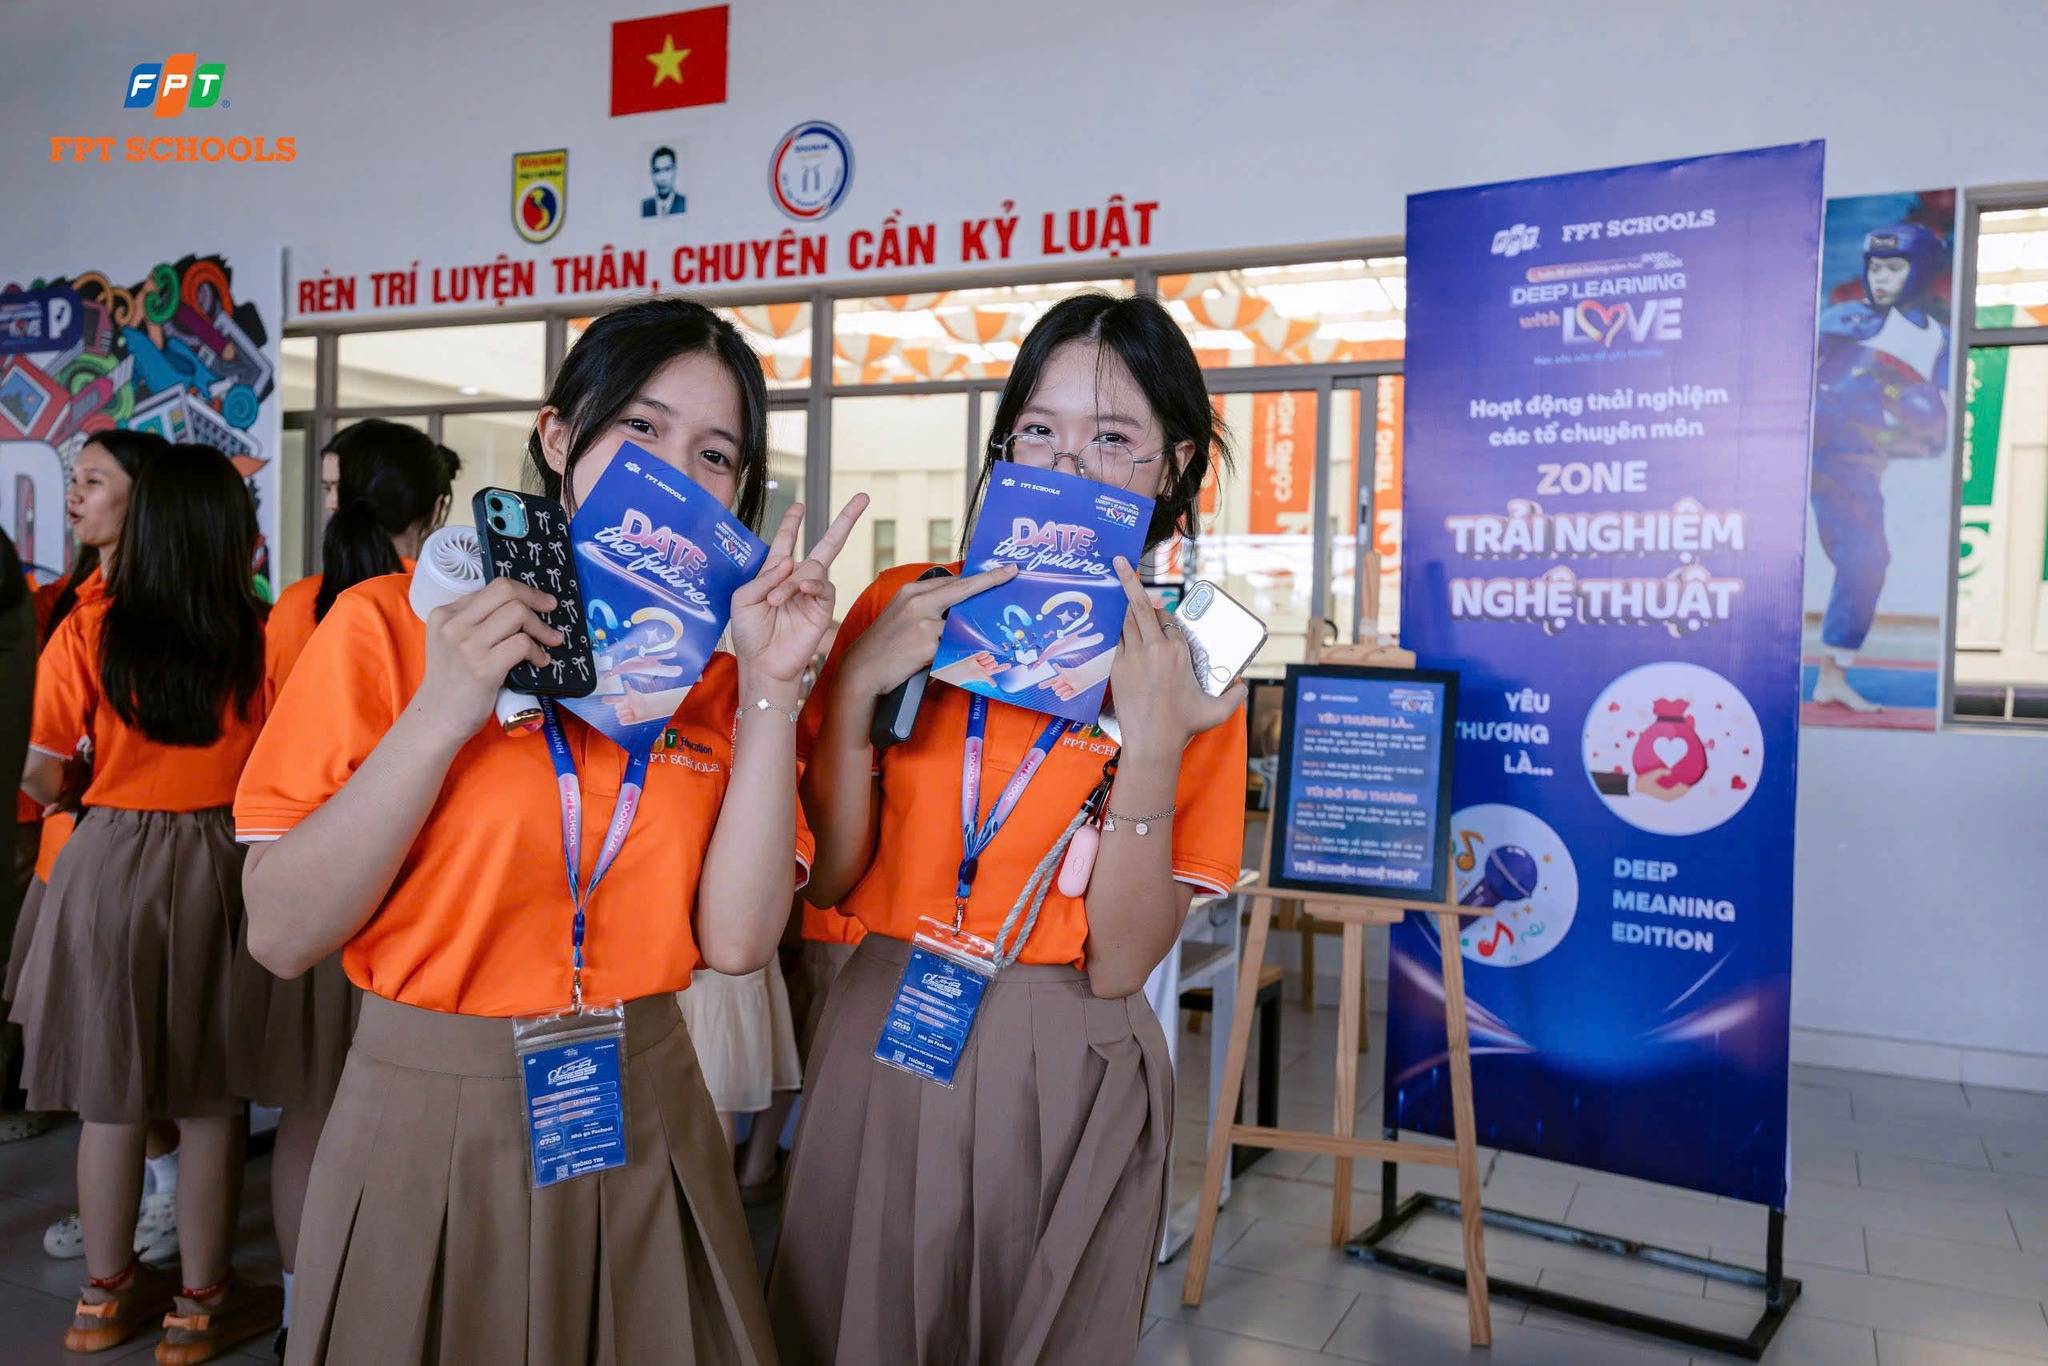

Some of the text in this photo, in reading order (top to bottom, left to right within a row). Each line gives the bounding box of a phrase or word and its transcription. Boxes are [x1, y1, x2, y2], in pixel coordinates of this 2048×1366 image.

[1562, 208, 1717, 242] FPT SCHOOLS
[297, 195, 1159, 314] RÈN TRÍ LUYỆN THÂN, CHUYÊN CẦN KỶ LUẬT
[1511, 272, 1687, 306] DEEP LEARNING
[1519, 310, 1560, 330] with
[1470, 383, 1728, 421] Hoạt động trải nghiệm
[1488, 417, 1704, 447] các tổ chuyên môn
[657, 480, 687, 503] SCHOOLS
[1536, 460, 1648, 495] ZONE
[621, 508, 707, 577] DATE
[1012, 517, 1098, 556] DATE
[1446, 498, 1547, 556] TRẢI
[1553, 497, 1745, 563] NGHIỆM
[594, 525, 642, 557] the
[627, 552, 711, 605] future
[993, 536, 1111, 576] the future
[1450, 565, 1744, 632] NGHỆ THUẬT
[1505, 688, 1550, 713] YÊU
[649, 753, 667, 764] PT
[1063, 738, 1087, 751] FPT
[967, 751, 977, 784] SCHOOL
[567, 808, 578, 848] SCHOOL
[615, 799, 633, 837] SCHOOL
[1613, 857, 1678, 882] DEEP
[1612, 889, 1736, 922] MEANING
[1611, 921, 1714, 953] EDITION
[539, 1135, 561, 1146] 07:30
